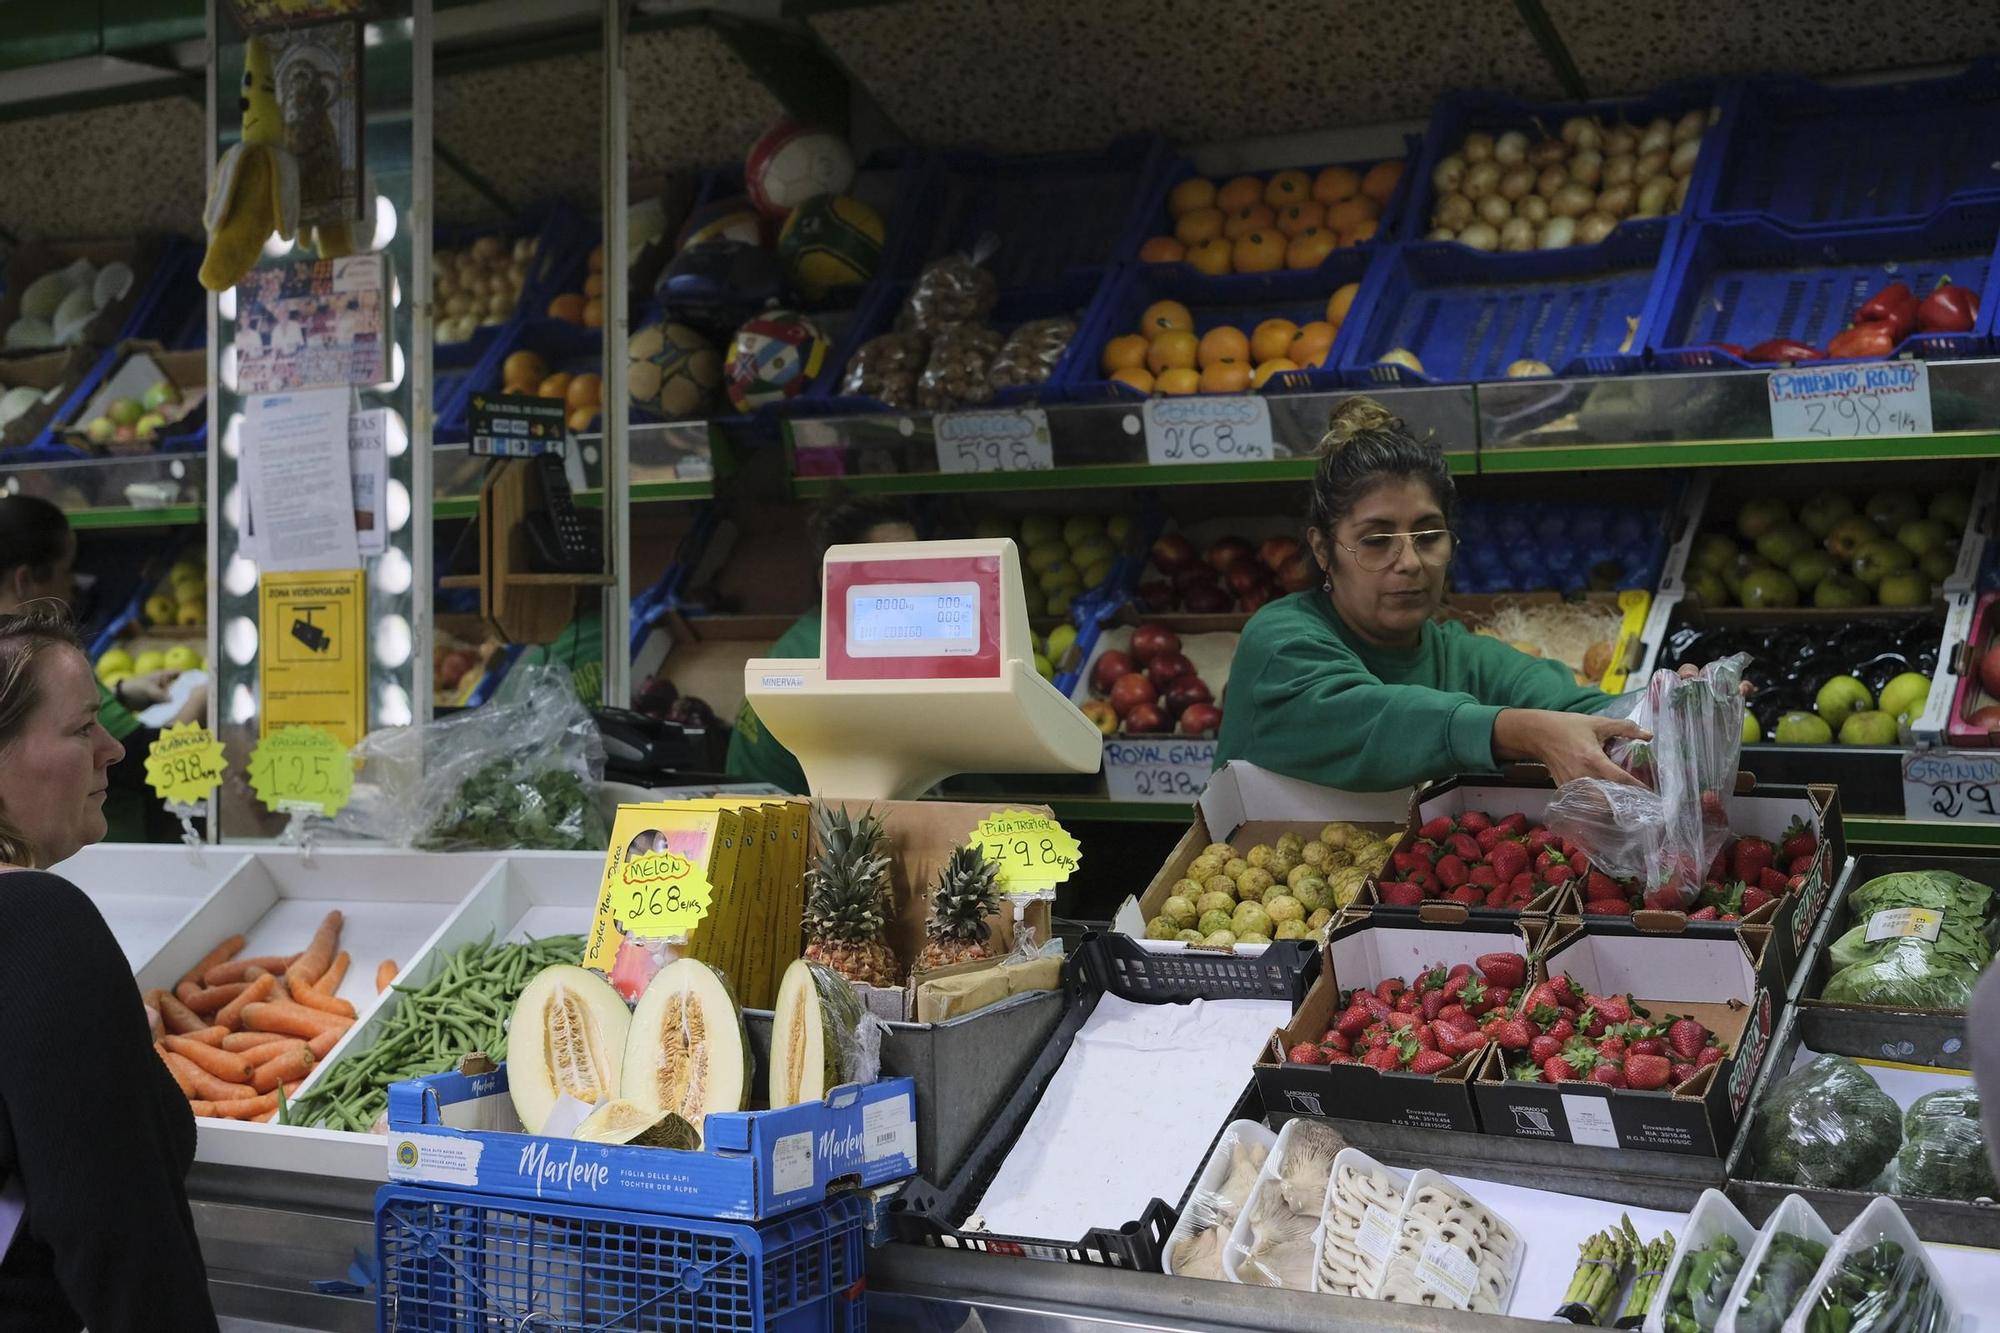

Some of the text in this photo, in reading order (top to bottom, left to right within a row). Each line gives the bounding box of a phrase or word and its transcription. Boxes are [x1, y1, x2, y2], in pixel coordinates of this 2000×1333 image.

[1865, 367, 1912, 388] ROJO
[1164, 424, 1236, 459] 2'68
[1105, 744, 1215, 766] ROYAL GALA
[1135, 770, 1191, 795] 2'98
[984, 820, 1013, 834] PIÑA
[630, 853, 681, 878] MELÓN
[628, 885, 681, 919] 2'68
[1515, 1128, 1556, 1137] CANARIAS
[818, 1124, 864, 1172] Marlen
[519, 1141, 609, 1197] Marlene
[620, 1169, 645, 1178] FIGLIA
[647, 1172, 670, 1180] DELLE
[620, 1180, 699, 1194] TOCHTER DER ALPEN
